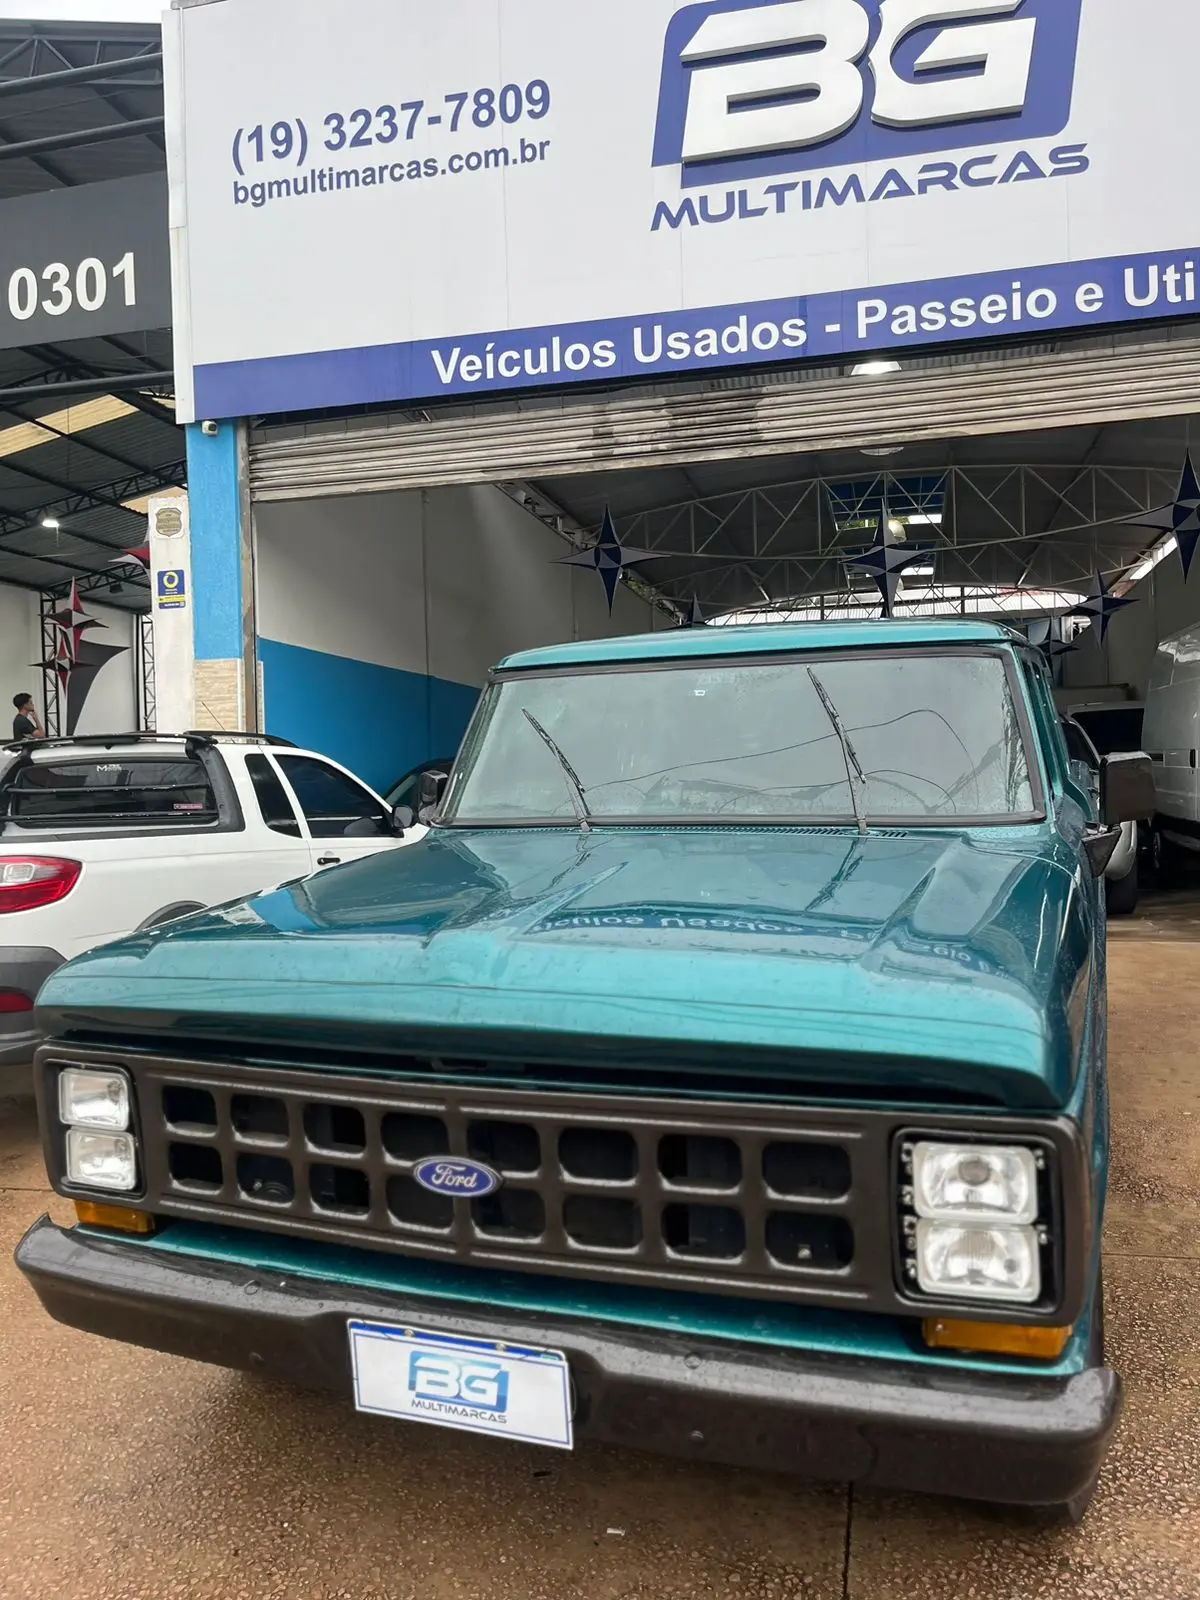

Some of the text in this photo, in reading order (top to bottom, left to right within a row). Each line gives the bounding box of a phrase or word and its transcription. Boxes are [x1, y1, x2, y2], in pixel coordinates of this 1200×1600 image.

[680, 0, 1037, 164] BG
[231, 79, 551, 176] (19) 3237-7809
[233, 138, 551, 208] bgmultimarcas.com.br
[650, 143, 1090, 232] MULTIMARCAS
[7, 252, 137, 321] 0301
[431, 335, 617, 384] Veículos
[633, 315, 808, 364] Usados
[856, 281, 1057, 339] Passeio
[1074, 282, 1105, 313] e
[431, 1163, 478, 1188] Ford
[411, 1399, 507, 1424] MULTIMARCAS
[414, 1356, 502, 1406] BG
